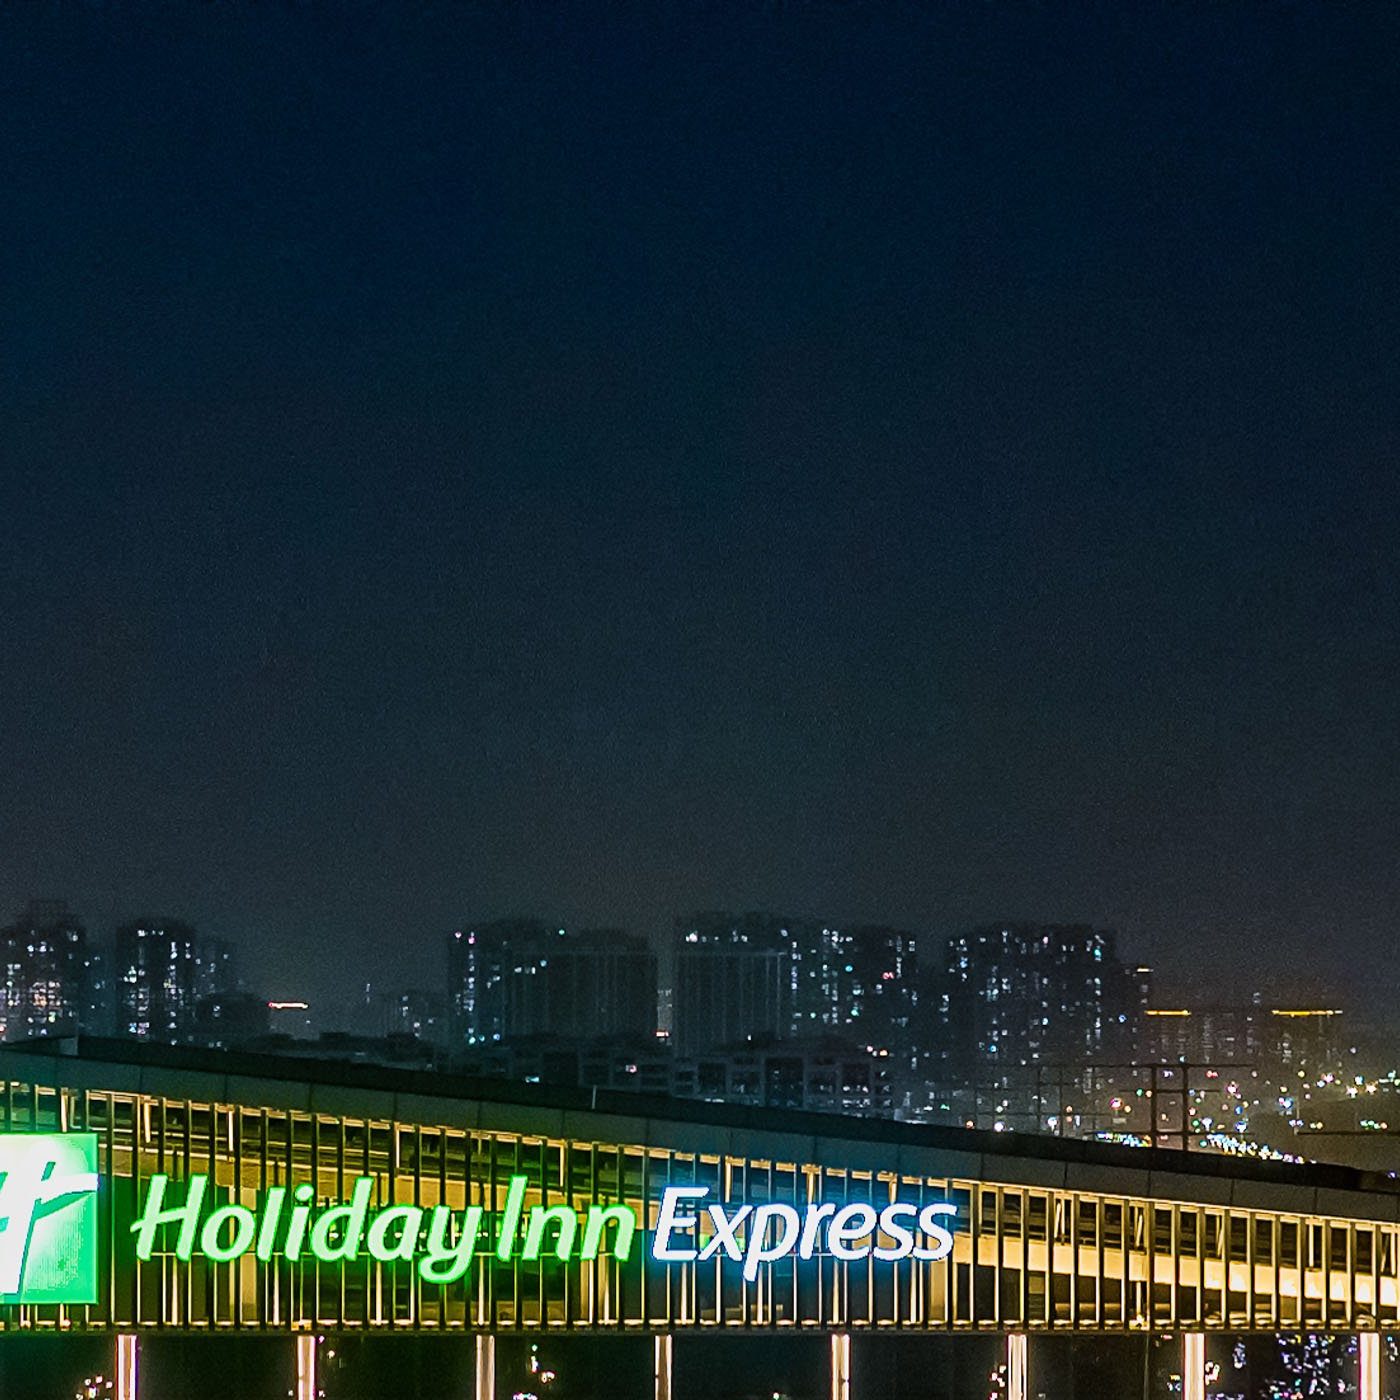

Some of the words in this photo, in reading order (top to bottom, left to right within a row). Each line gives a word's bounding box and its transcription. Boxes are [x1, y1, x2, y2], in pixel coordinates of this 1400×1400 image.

[129, 1173, 485, 1284] Holiday
[495, 1174, 637, 1262] Inn
[650, 1185, 958, 1283] Express
